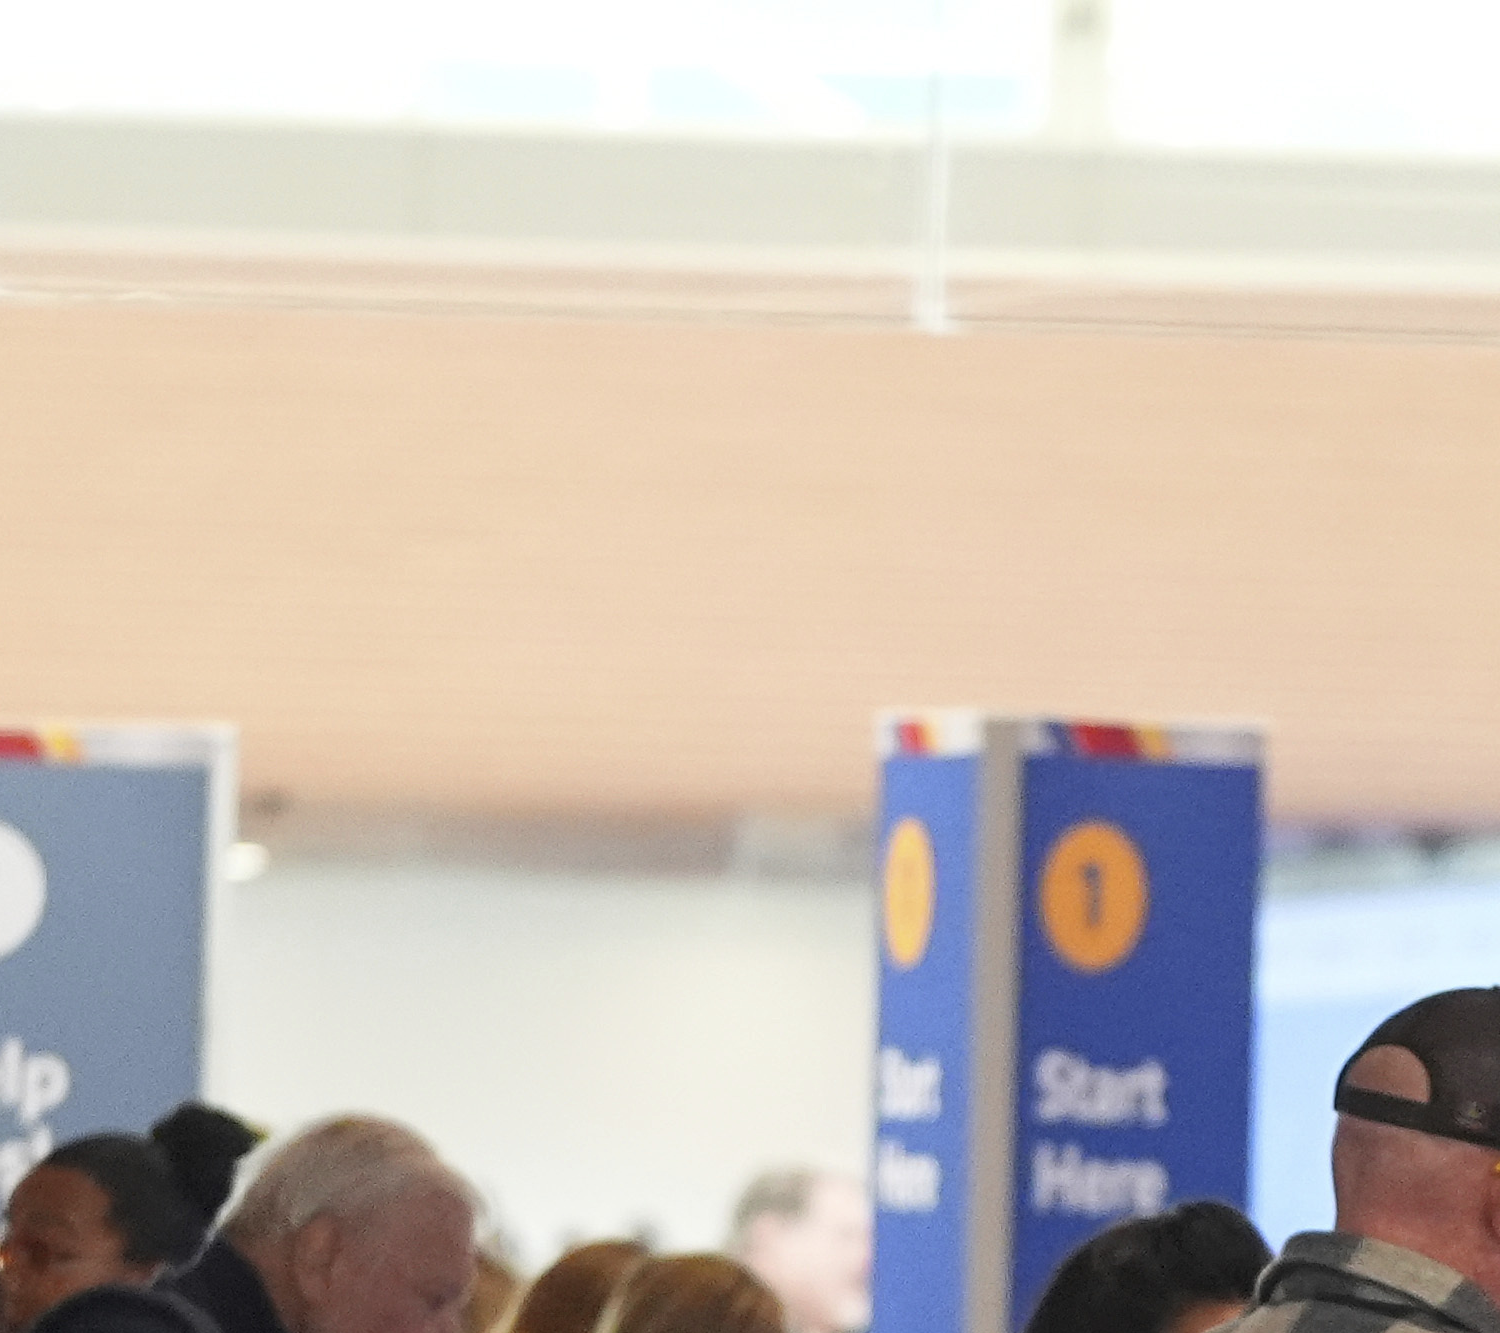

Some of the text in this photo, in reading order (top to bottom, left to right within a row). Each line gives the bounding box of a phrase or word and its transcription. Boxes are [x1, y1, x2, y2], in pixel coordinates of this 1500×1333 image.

[1081, 861, 1103, 929] 1
[1036, 1051, 1167, 1126] Start
[1034, 1141, 1167, 1216] Here
